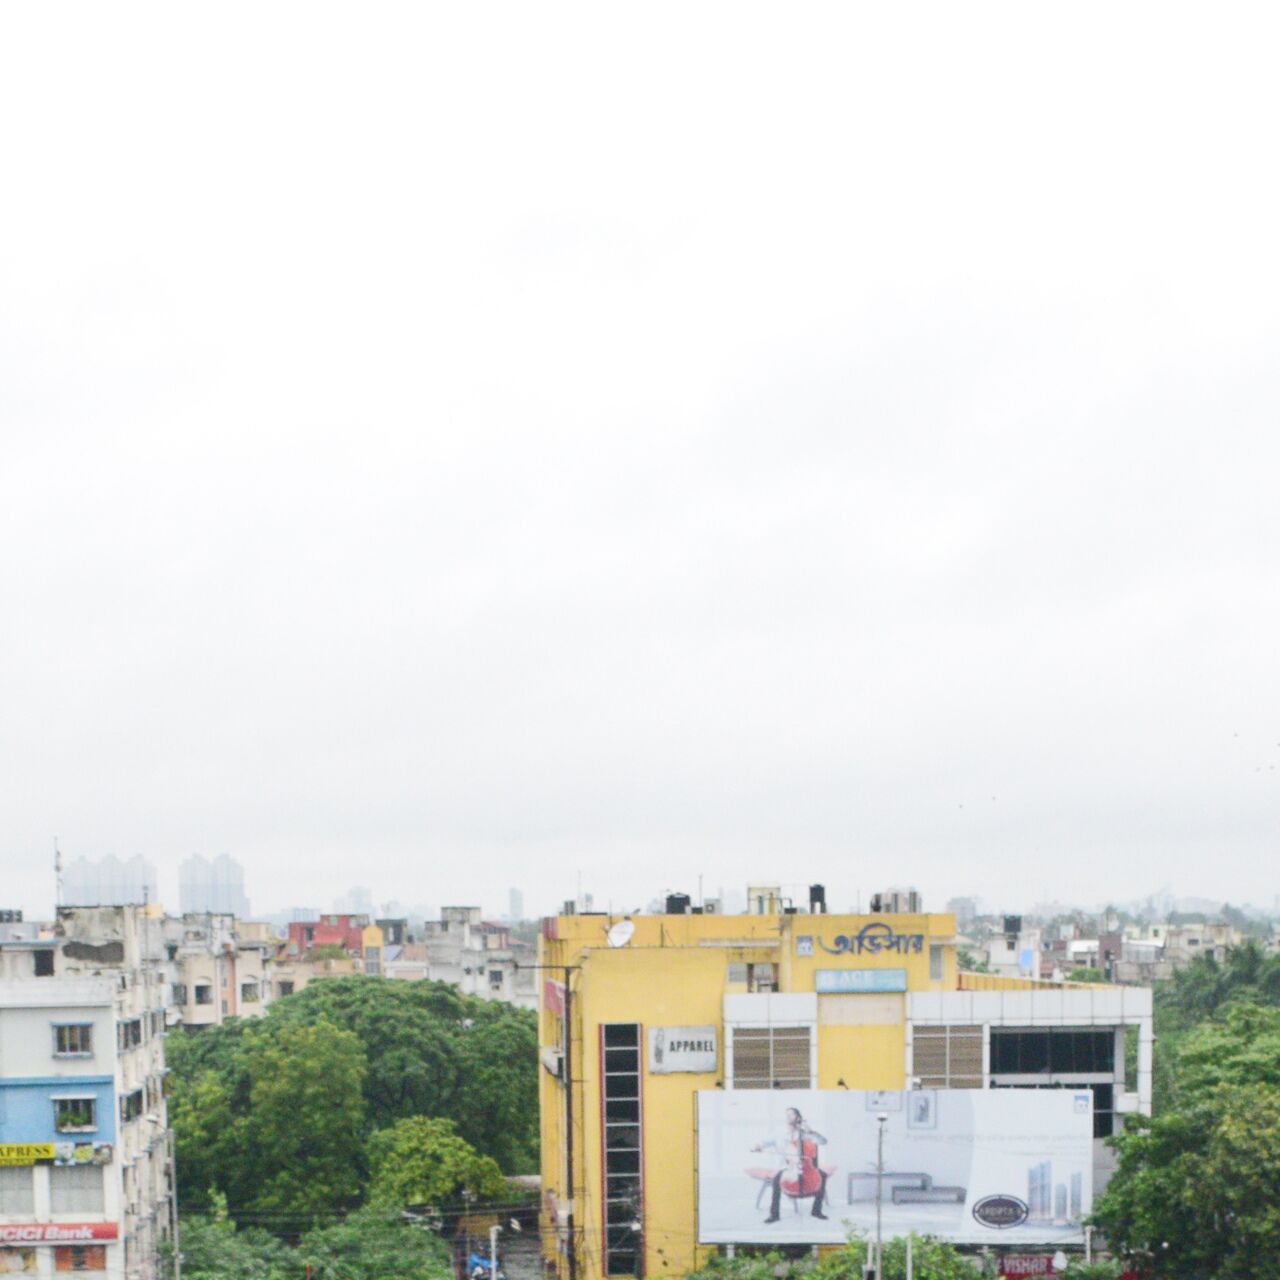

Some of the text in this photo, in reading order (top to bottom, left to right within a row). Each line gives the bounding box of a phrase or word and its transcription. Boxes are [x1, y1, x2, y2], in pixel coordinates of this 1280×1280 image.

[817, 922, 924, 955] অভিসার
[669, 1040, 714, 1052] APPAREL
[44, 1226, 93, 1240] Bank
